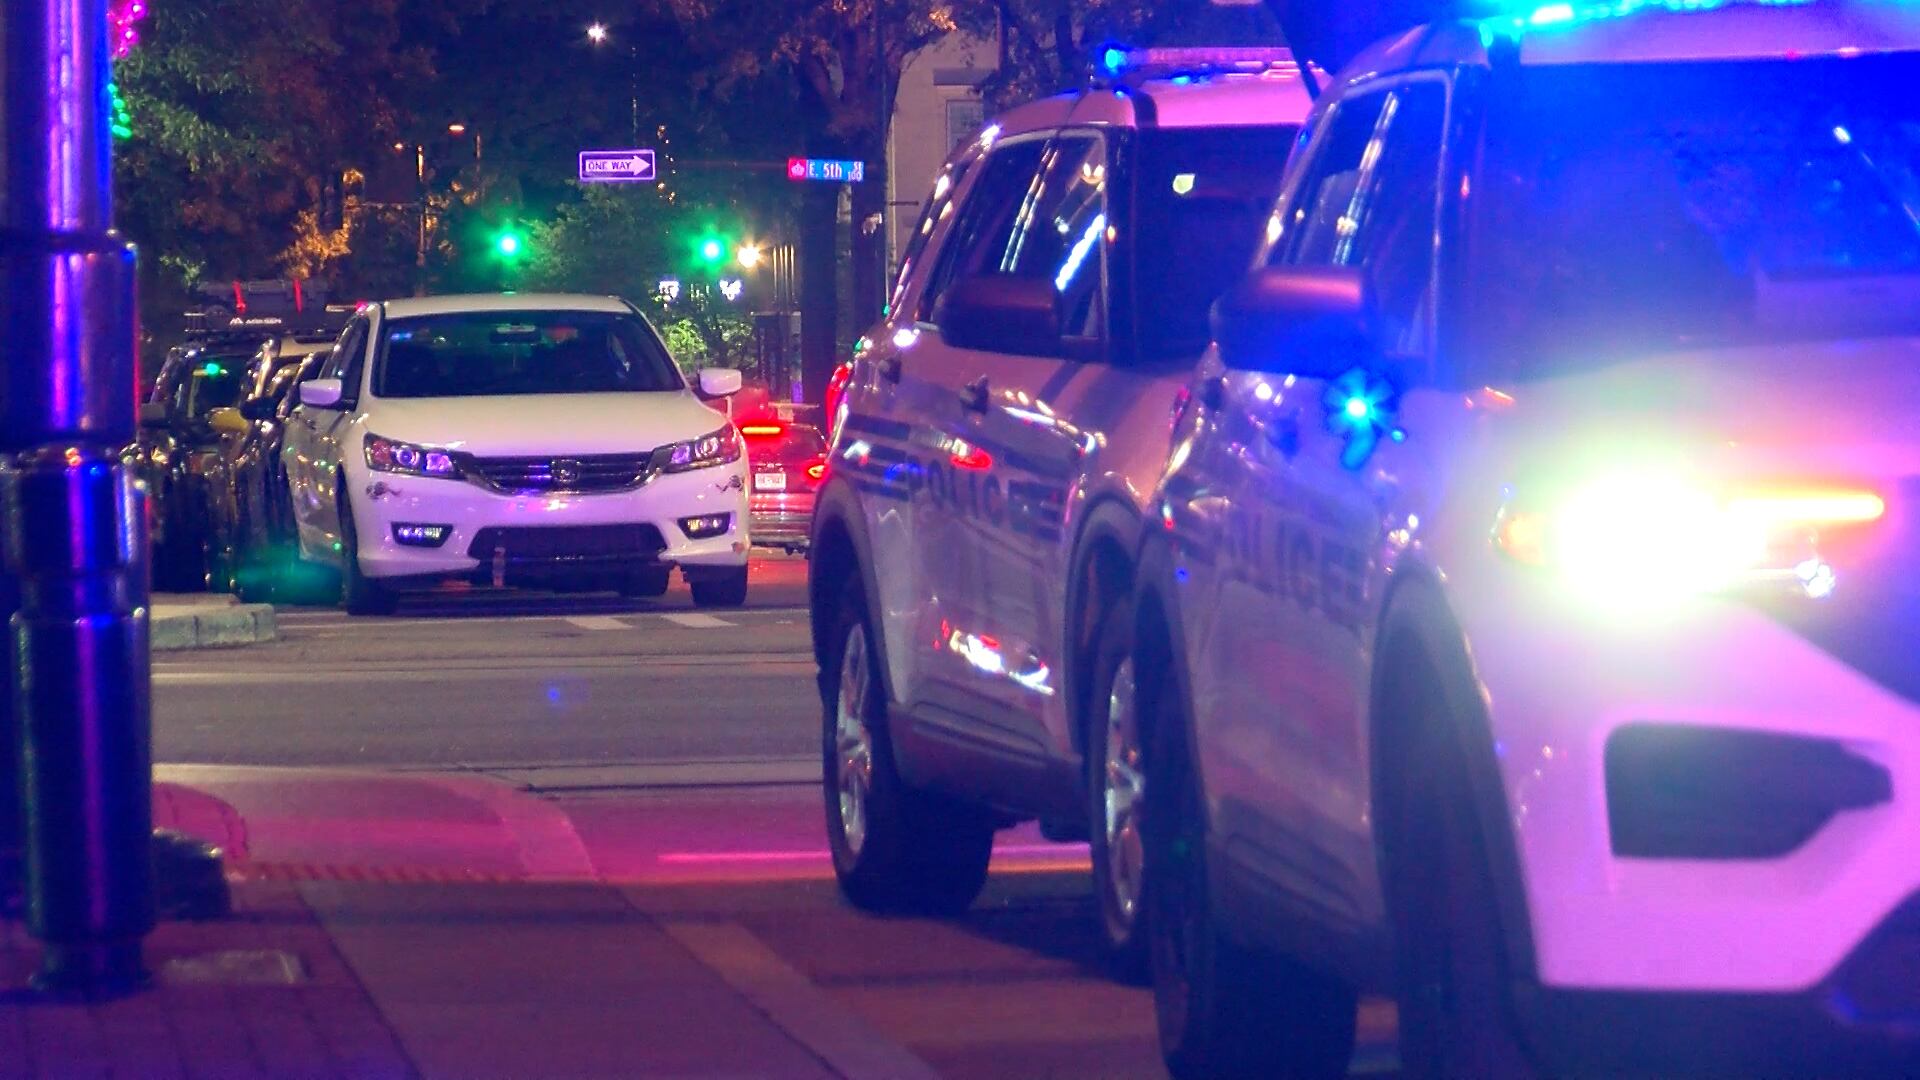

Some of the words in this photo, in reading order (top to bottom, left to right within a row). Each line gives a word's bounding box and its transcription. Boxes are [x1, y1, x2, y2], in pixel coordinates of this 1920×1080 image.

[588, 161, 607, 170] ONE
[612, 161, 631, 170] WAY
[809, 162, 819, 176] E.
[823, 162, 842, 177] 5th
[907, 455, 1034, 535] POLICE
